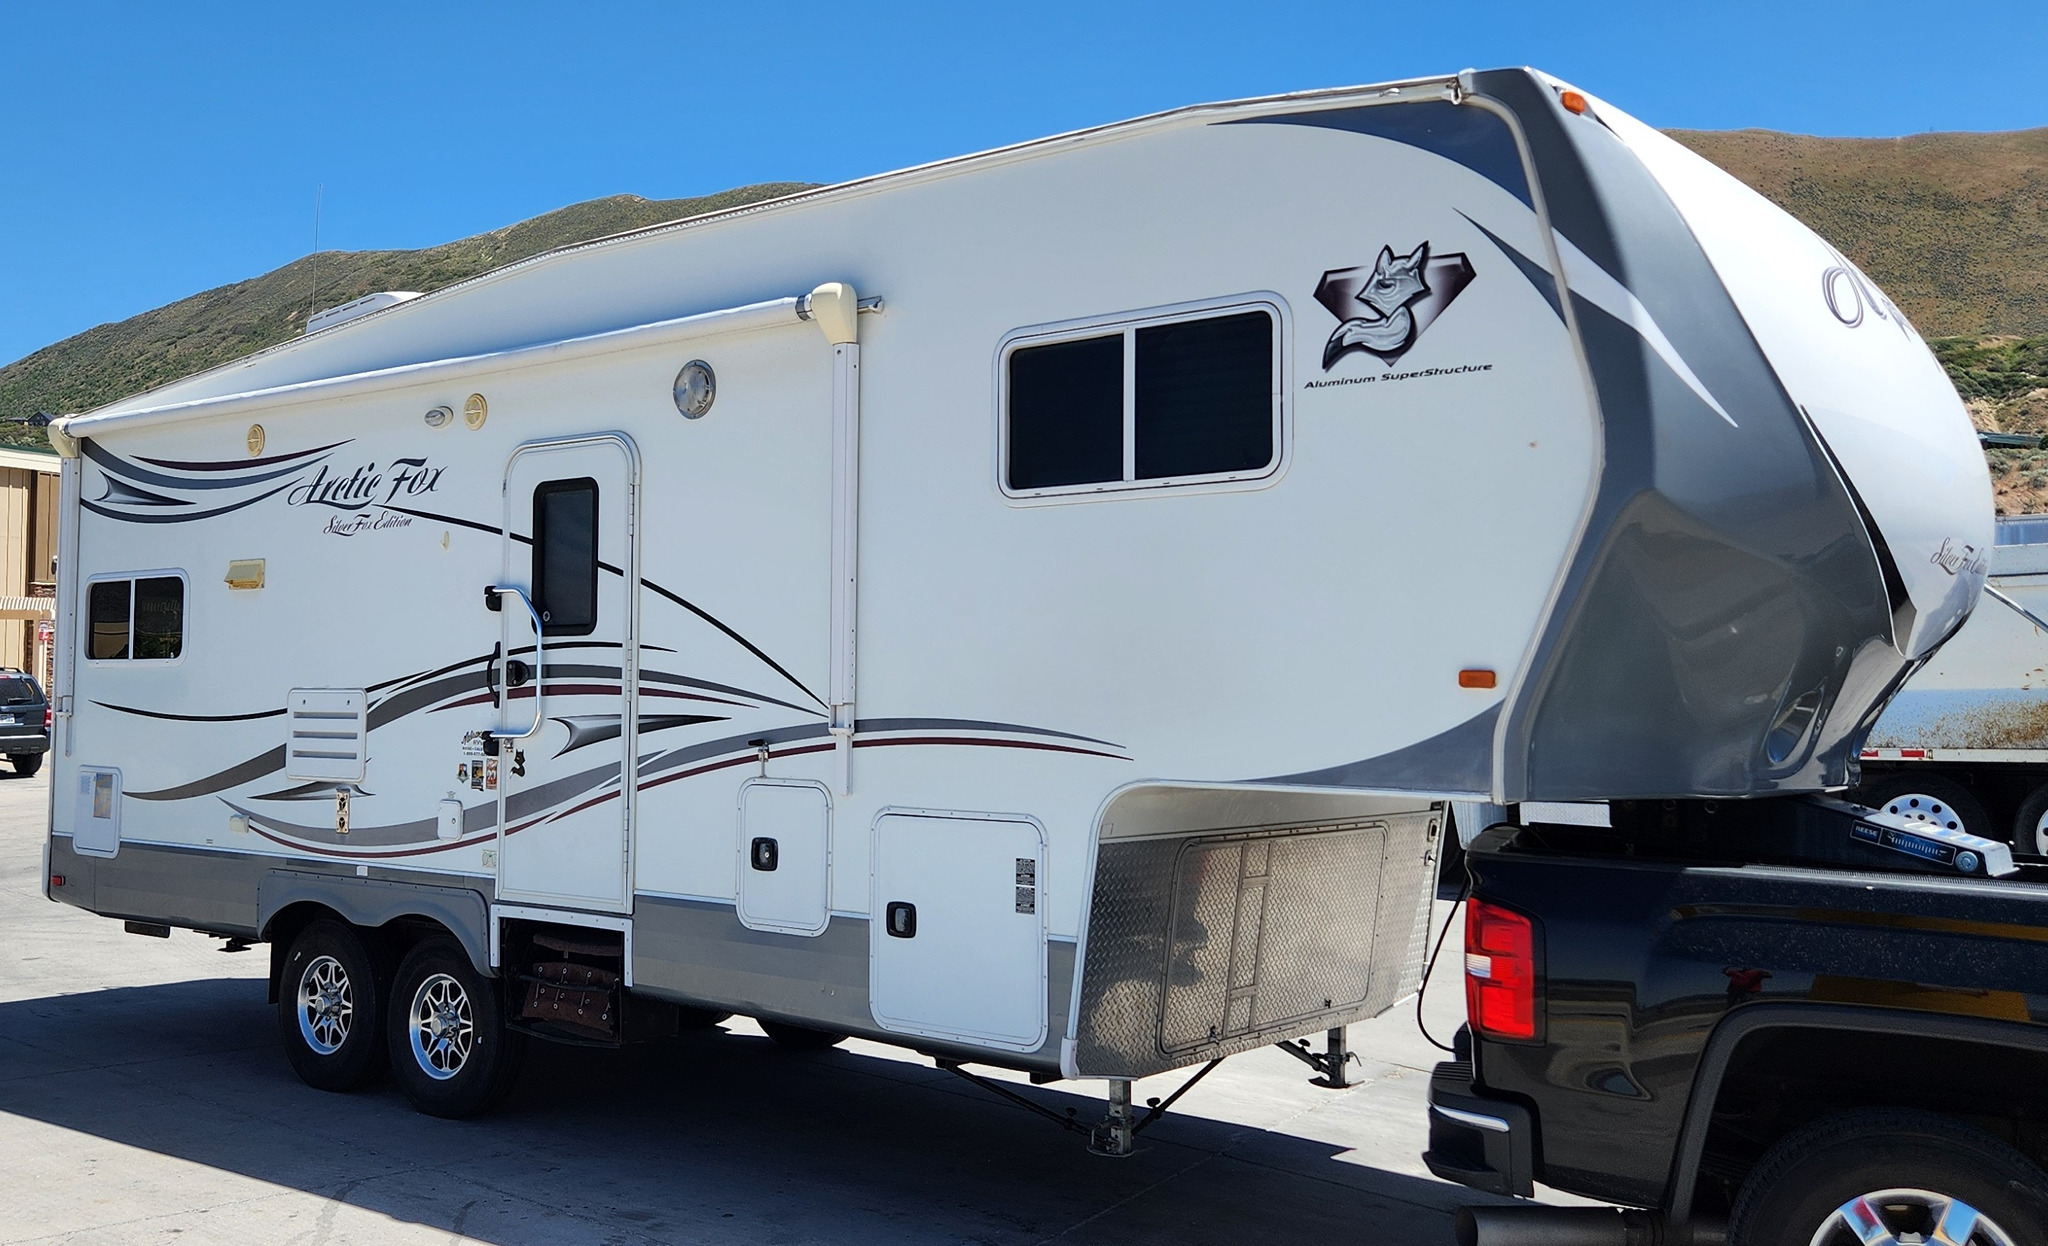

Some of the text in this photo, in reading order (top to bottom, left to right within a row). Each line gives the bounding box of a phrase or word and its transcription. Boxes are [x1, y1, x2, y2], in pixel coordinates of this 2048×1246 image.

[1303, 364, 1493, 390] Aluminum SuperStructure
[287, 456, 449, 511] Arctic Fox
[323, 511, 412, 537] Silver Fox Edition
[1855, 825, 1878, 836] REESE
